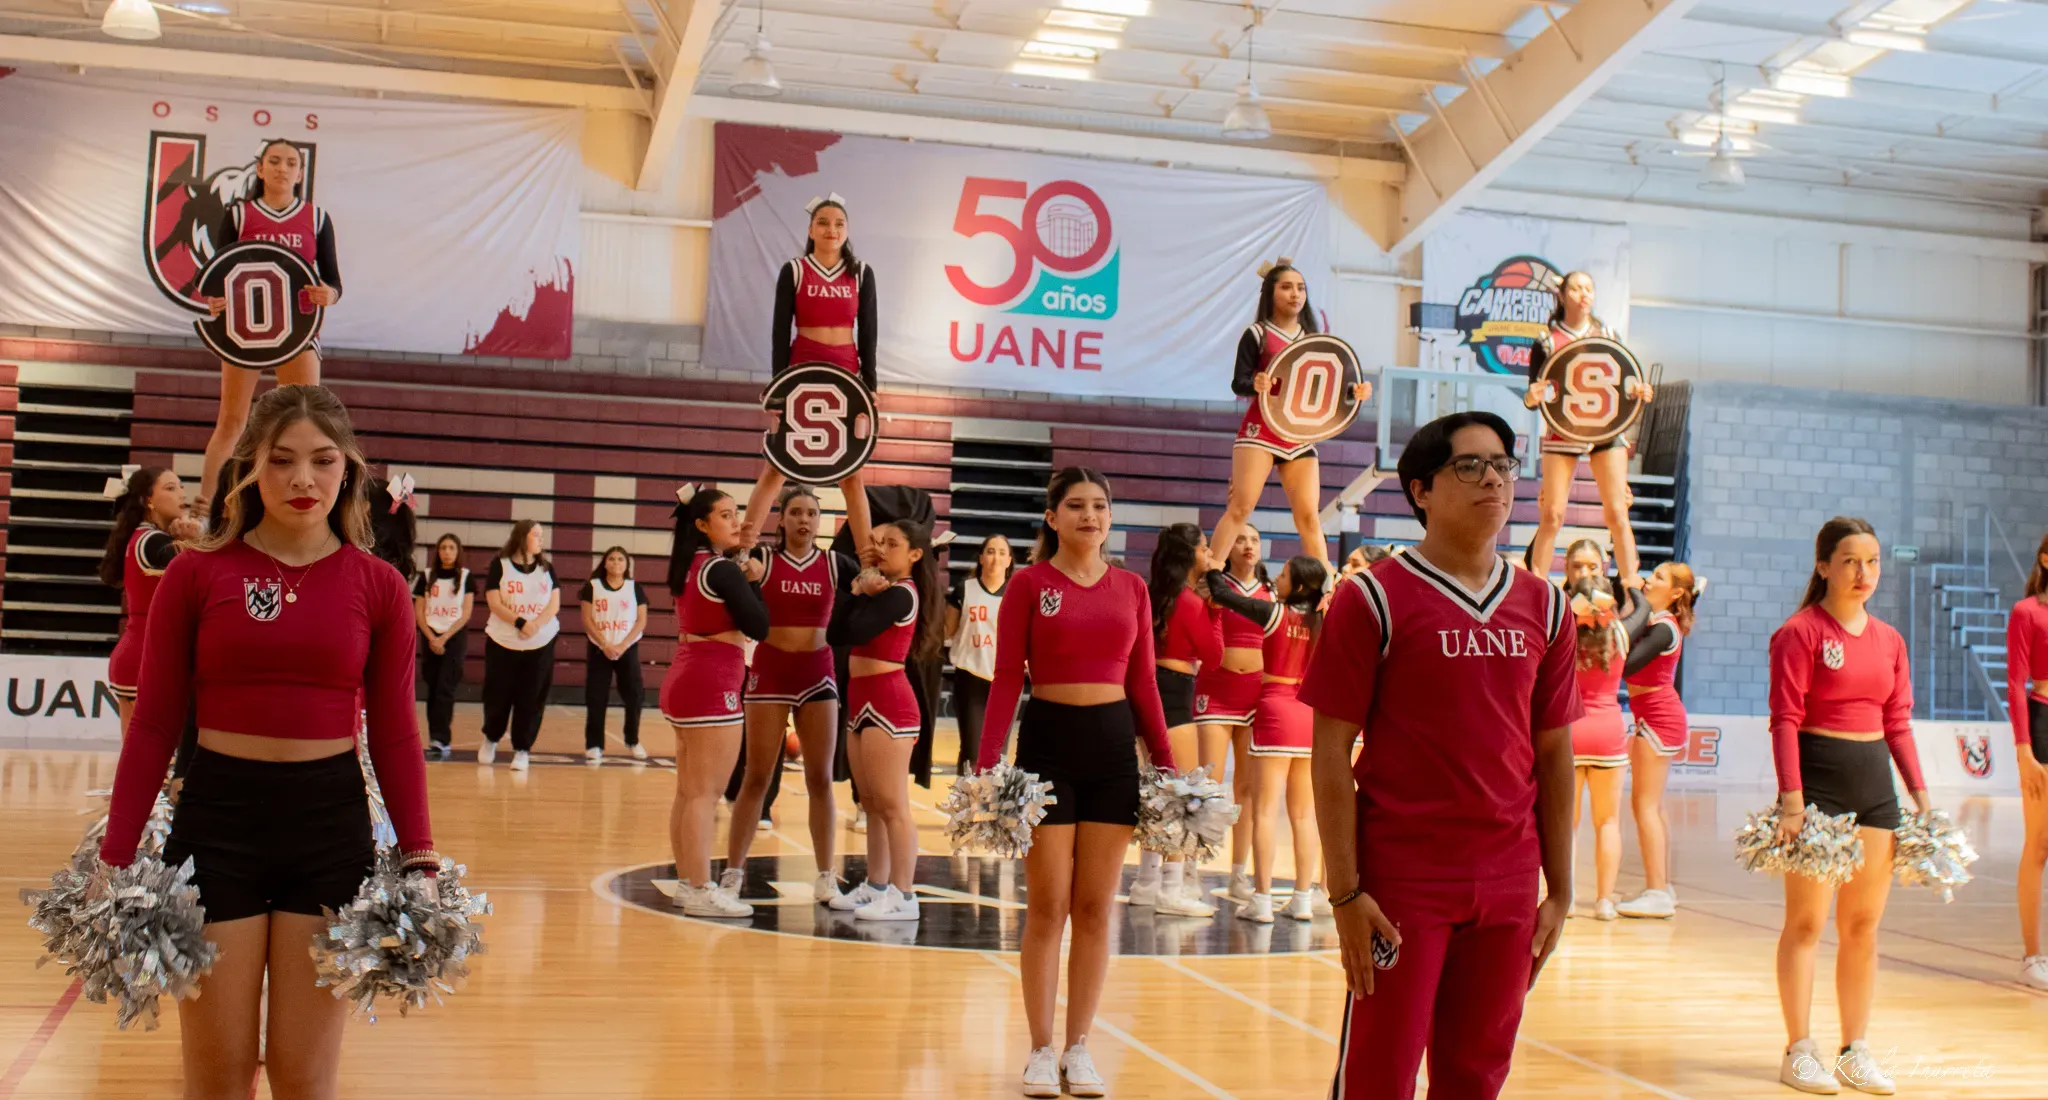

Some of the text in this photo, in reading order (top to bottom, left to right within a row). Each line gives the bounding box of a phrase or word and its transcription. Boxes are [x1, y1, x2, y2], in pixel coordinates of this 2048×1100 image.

[944, 176, 1113, 306] 50
[807, 284, 853, 299] UANE
[1041, 285, 1107, 313] años
[1459, 287, 1556, 316] CAMPEON
[1487, 303, 1552, 325] NACION
[949, 320, 1104, 372] UANE
[1561, 353, 1622, 427] S
[785, 383, 848, 466] S
[507, 580, 524, 595] 50
[781, 579, 822, 596] UANE
[595, 599, 609, 613] 50
[969, 604, 989, 623] 50
[971, 633, 995, 649] UA
[1437, 628, 1528, 658] UANE
[7, 676, 121, 719] UAN
